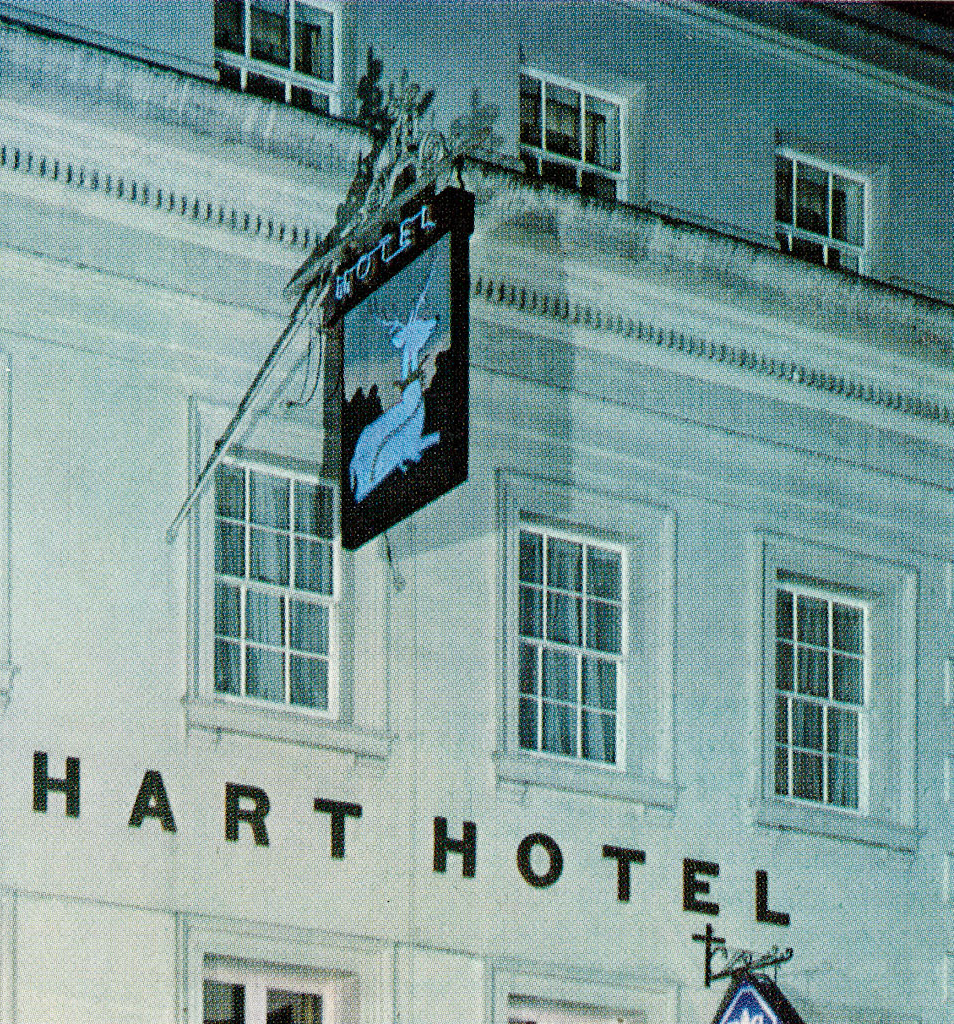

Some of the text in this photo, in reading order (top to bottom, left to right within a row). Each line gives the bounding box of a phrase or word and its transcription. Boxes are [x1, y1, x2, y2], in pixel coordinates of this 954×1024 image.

[334, 205, 436, 301] HOTEL
[32, 750, 363, 860] HART
[432, 815, 792, 928] HOTEL
